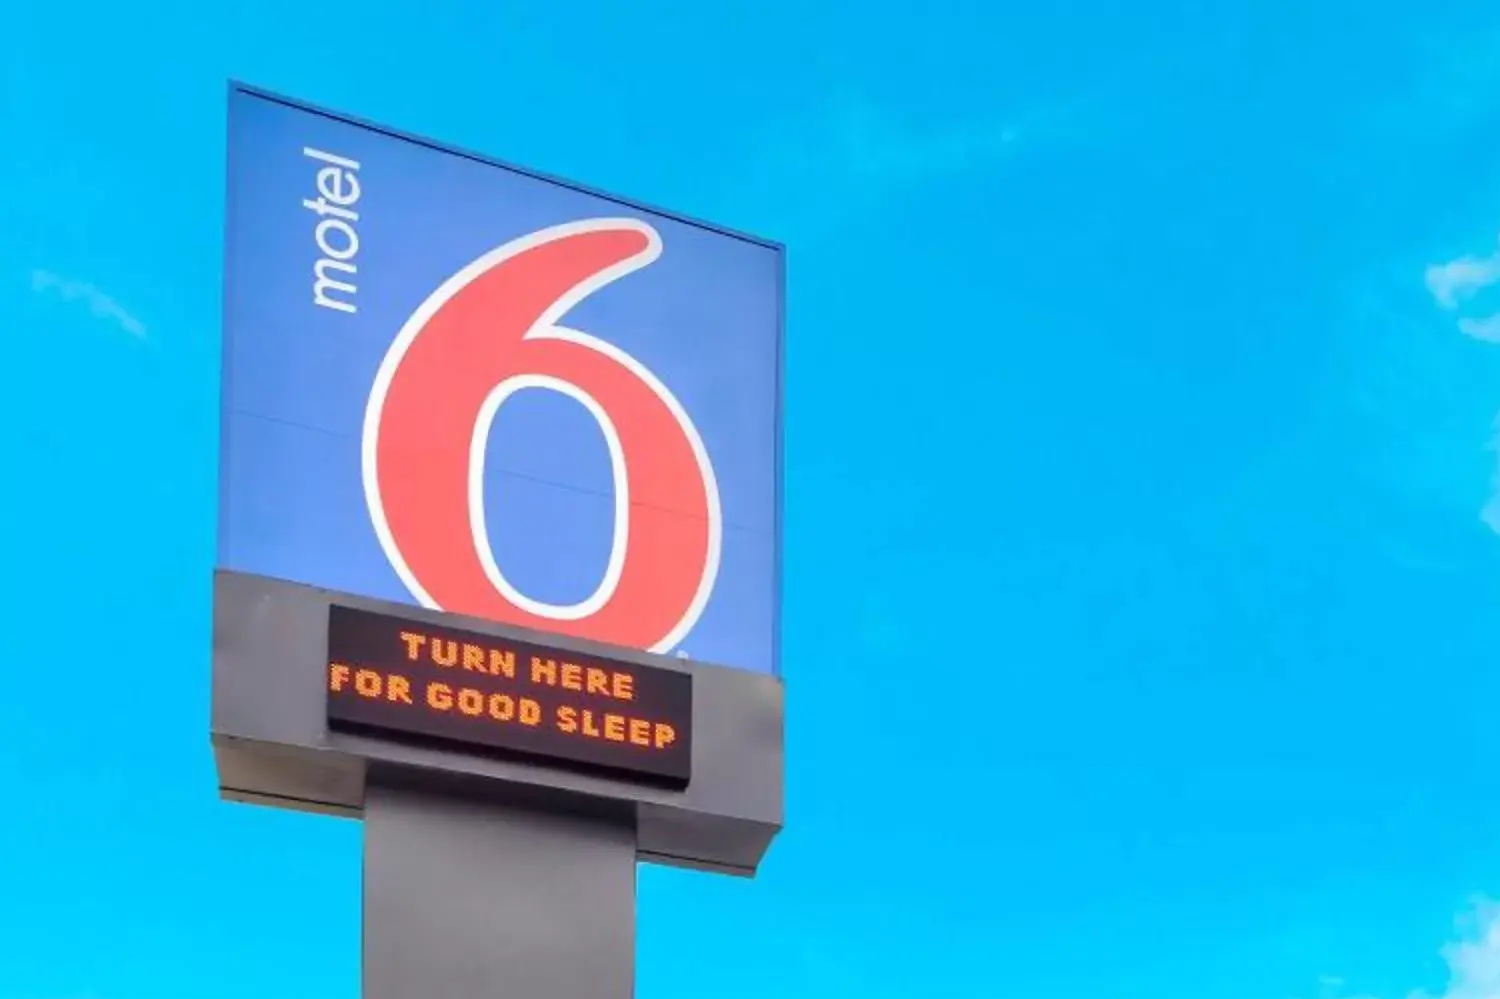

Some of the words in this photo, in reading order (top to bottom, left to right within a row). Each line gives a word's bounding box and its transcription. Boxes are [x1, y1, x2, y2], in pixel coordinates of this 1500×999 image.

[303, 146, 361, 313] motel
[362, 217, 722, 655] 6
[329, 663, 413, 704] FOR
[426, 681, 542, 727] GOOD
[556, 705, 676, 749] SLEEP
[401, 631, 516, 678] TURN
[531, 656, 634, 700] HERE
